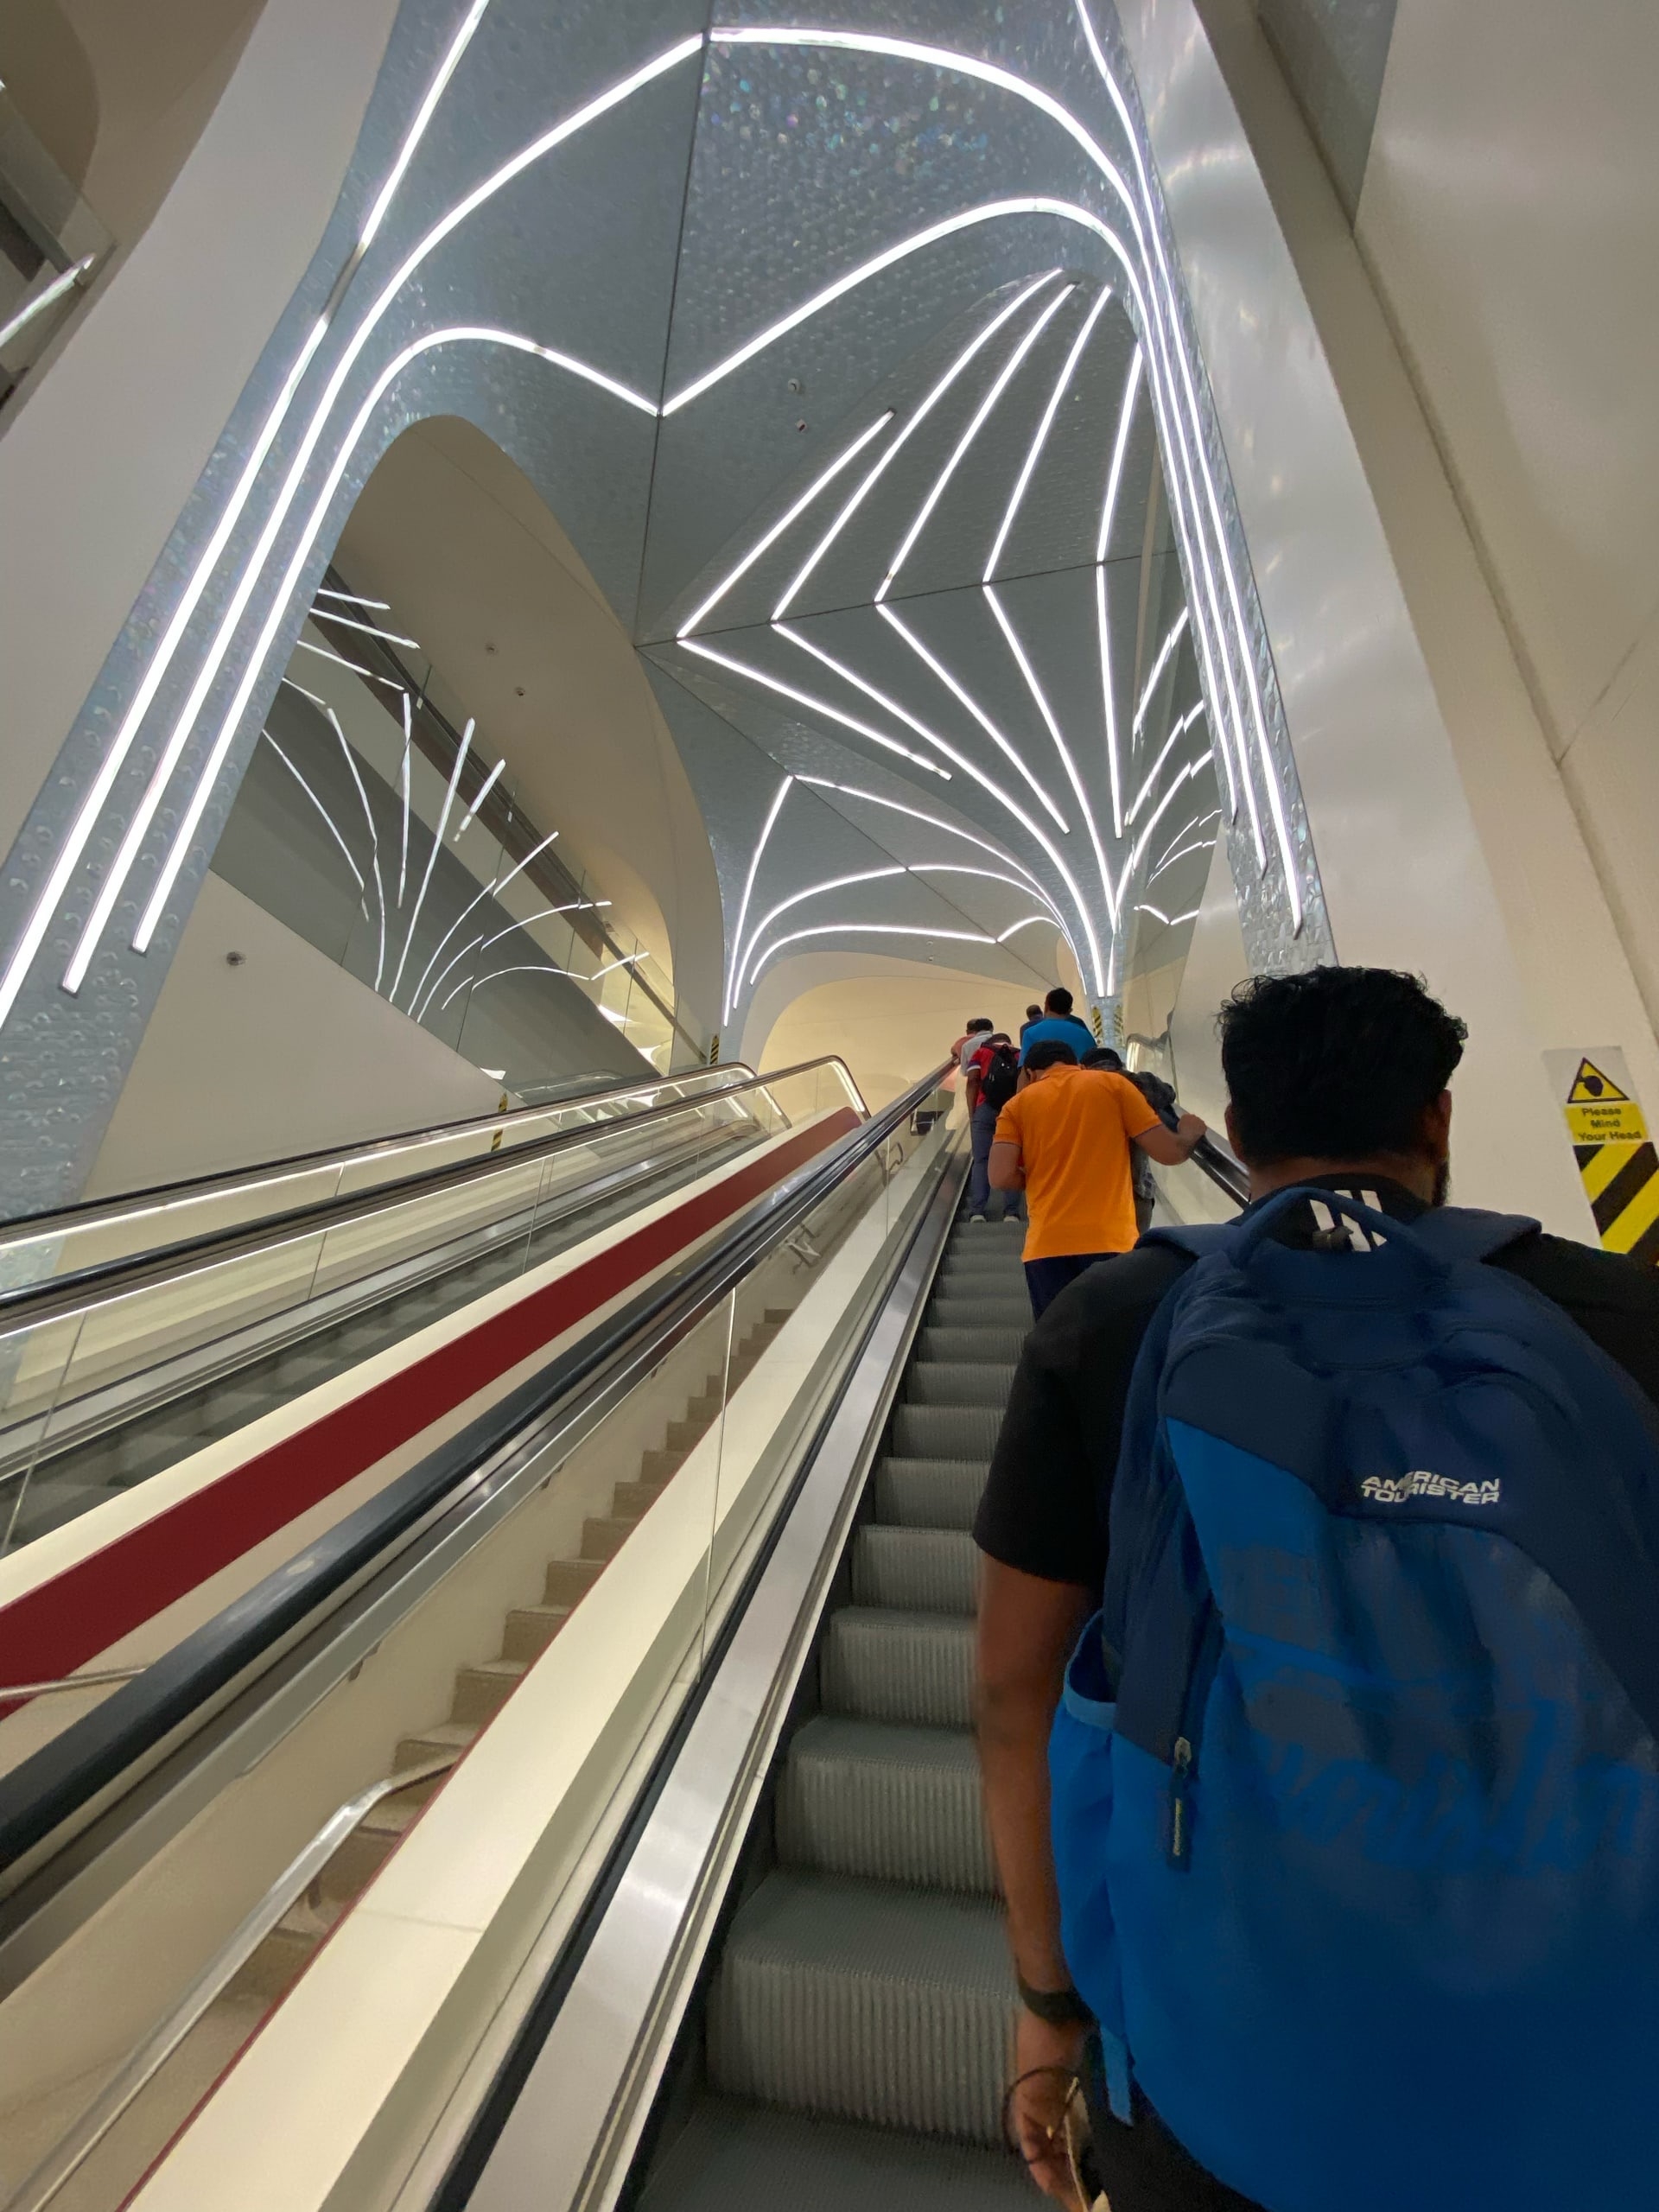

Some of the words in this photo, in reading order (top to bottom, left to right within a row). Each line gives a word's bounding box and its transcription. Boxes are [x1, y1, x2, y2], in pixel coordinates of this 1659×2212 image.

[1582, 1108, 1622, 1116] Please
[1591, 1119, 1621, 1128] Mind
[1578, 1132, 1606, 1141] Your
[1609, 1130, 1642, 1140] Head
[1362, 1471, 1500, 1493] AMRICAN
